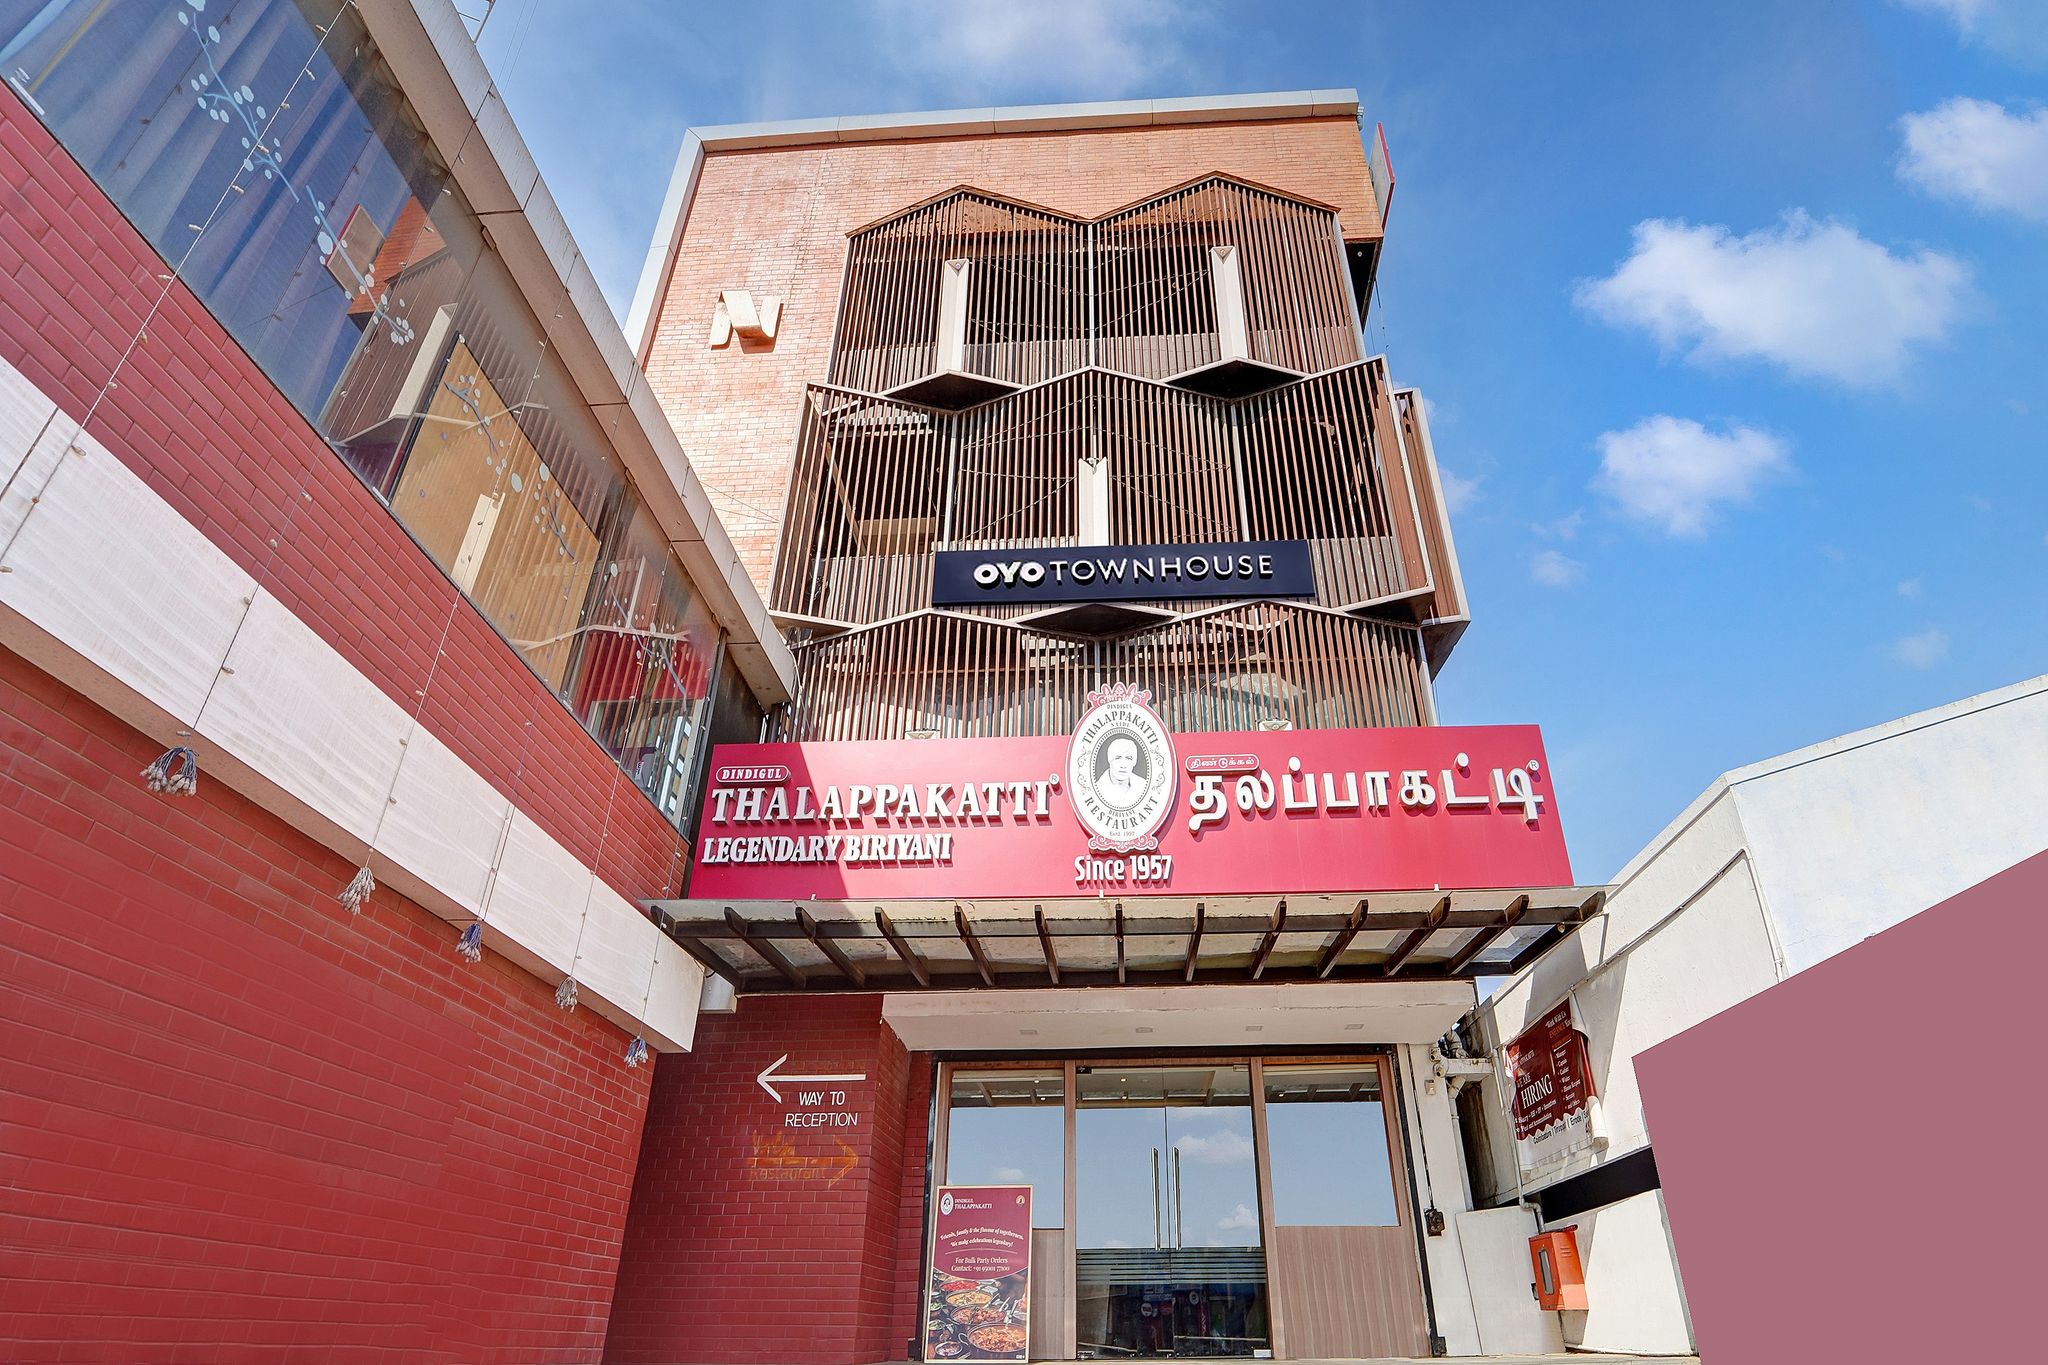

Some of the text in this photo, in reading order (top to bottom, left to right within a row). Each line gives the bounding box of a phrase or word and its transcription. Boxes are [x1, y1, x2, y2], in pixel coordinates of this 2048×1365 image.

[973, 555, 1274, 585] OYO TOWNHOUSE
[1081, 710, 1159, 745] THALAPPAKATTI
[1190, 756, 1255, 770] திண்டுக்கல்
[721, 768, 783, 781] DINDIGUL
[1084, 796, 1159, 830] RESTAURANT
[701, 833, 953, 864] LEGENDARY BIRIYANI
[1074, 855, 1173, 881] Since 1957
[799, 1090, 846, 1106] WAY TO
[1521, 1074, 1553, 1109] HIRING
[784, 1112, 858, 1127] RECEPTION
[1570, 1114, 1582, 1126] Erode
[964, 1256, 976, 1264] Bulk
[976, 1256, 990, 1265] Party
[990, 1256, 1008, 1264] Orders
